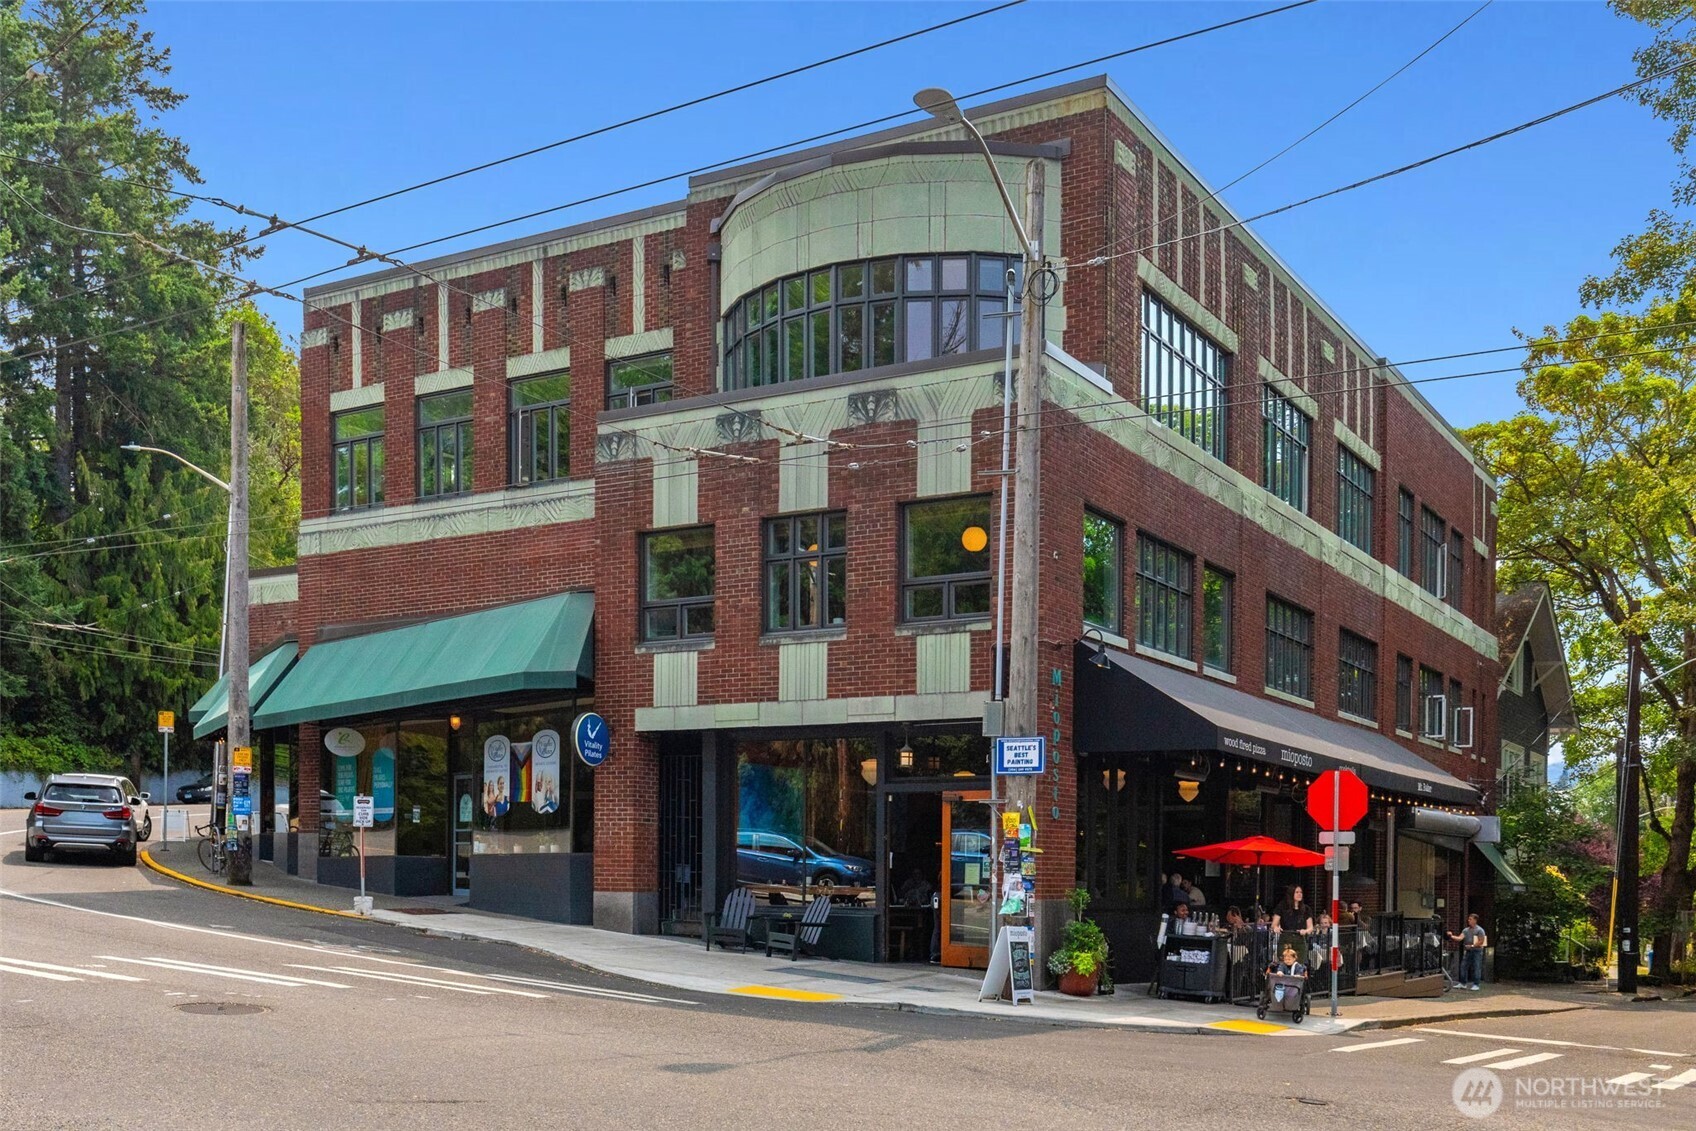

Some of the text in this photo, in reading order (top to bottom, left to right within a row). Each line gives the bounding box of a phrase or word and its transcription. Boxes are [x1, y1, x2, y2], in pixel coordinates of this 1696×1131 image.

[584, 740, 603, 751] Vitality
[1052, 668, 1062, 819] Mioposto
[1223, 737, 1267, 756] wood fired pizza
[584, 749, 602, 759] Pilates
[1281, 748, 1313, 767] mioposto
